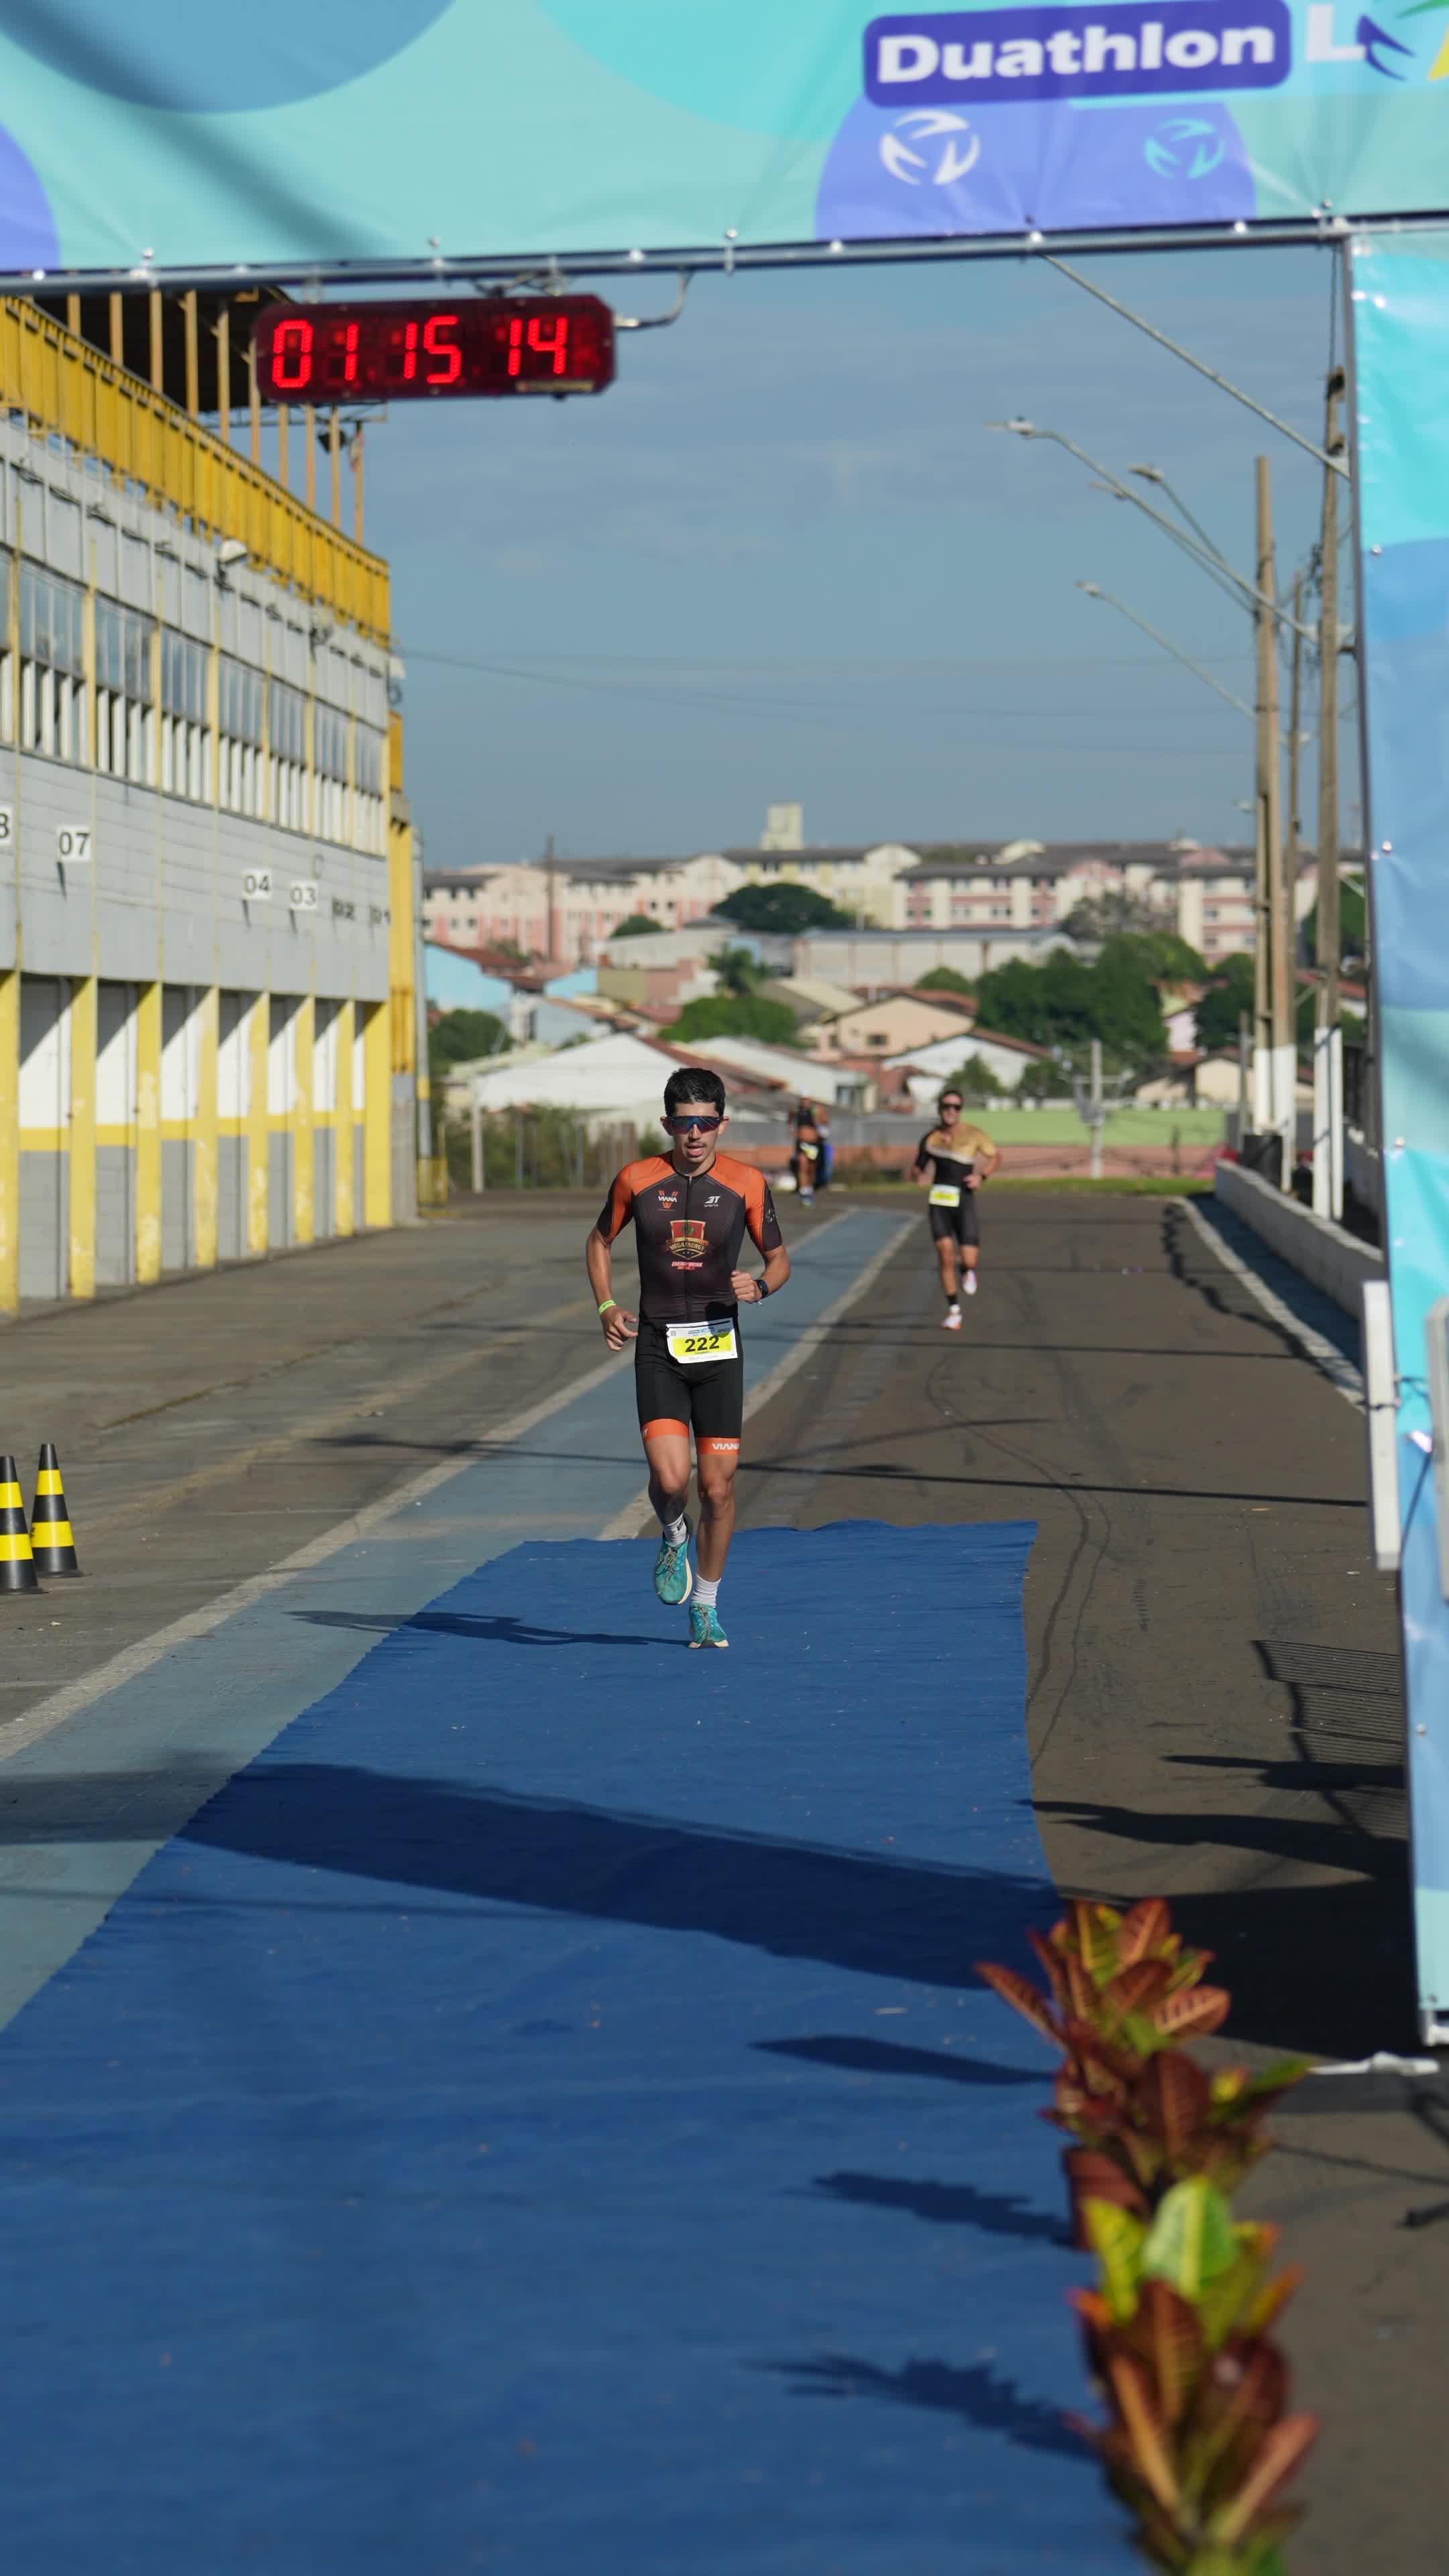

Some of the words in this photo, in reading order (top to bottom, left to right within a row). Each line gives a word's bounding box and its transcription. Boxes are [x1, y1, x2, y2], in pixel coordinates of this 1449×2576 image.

[877, 22, 1275, 83] Duathlon
[272, 320, 359, 388] 01
[403, 315, 462, 384] 15
[508, 317, 568, 376] 14
[59, 832, 91, 855] 07
[244, 875, 270, 894] 04
[290, 887, 317, 906] 03
[685, 1336, 720, 1352] 222
